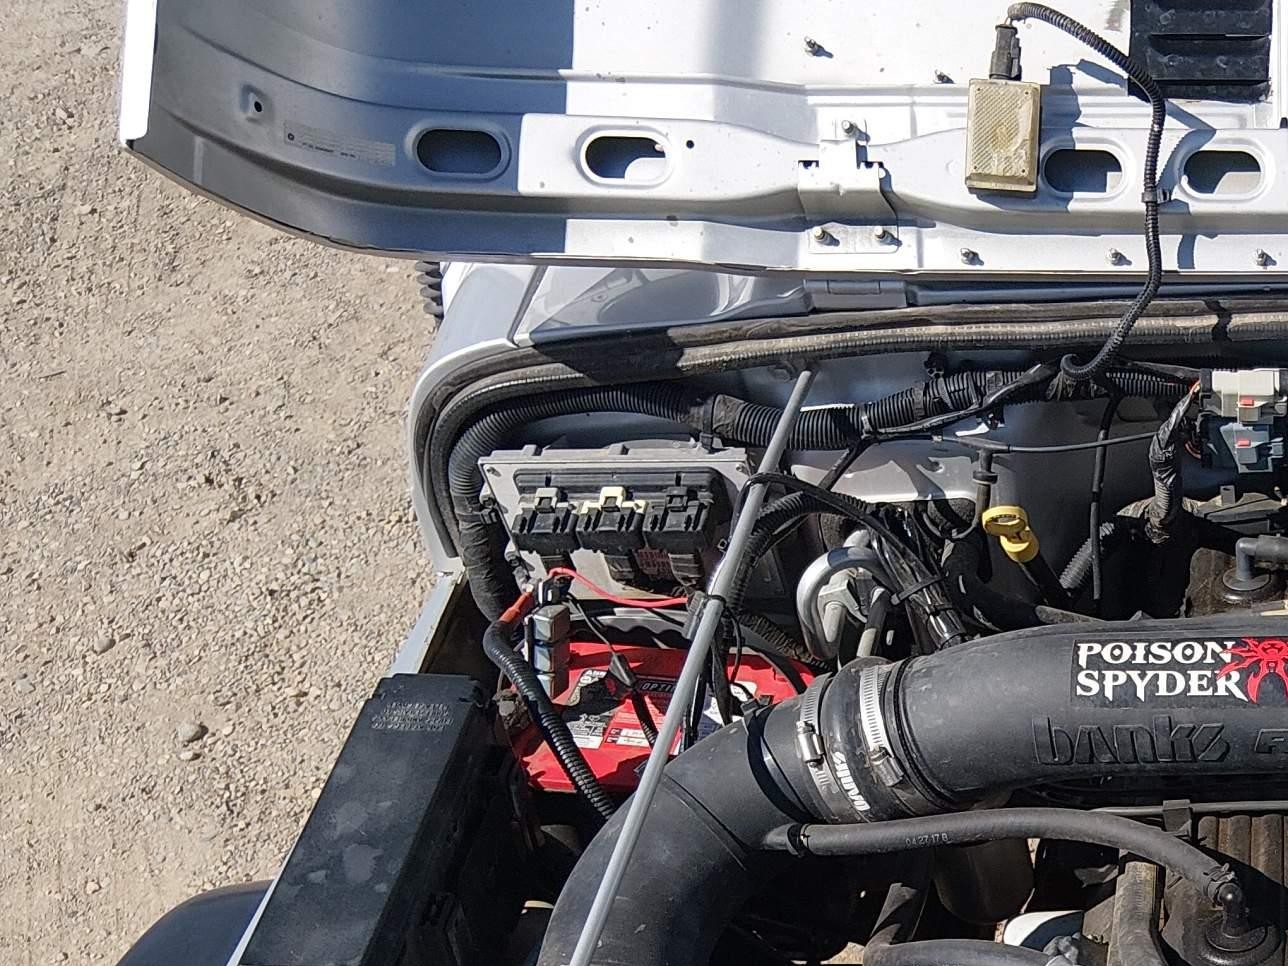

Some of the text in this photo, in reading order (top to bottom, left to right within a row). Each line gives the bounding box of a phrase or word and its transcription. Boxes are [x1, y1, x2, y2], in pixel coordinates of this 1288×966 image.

[1077, 640, 1236, 669] POISON
[1076, 669, 1249, 702] SPYDER
[1032, 714, 1231, 765] banks
